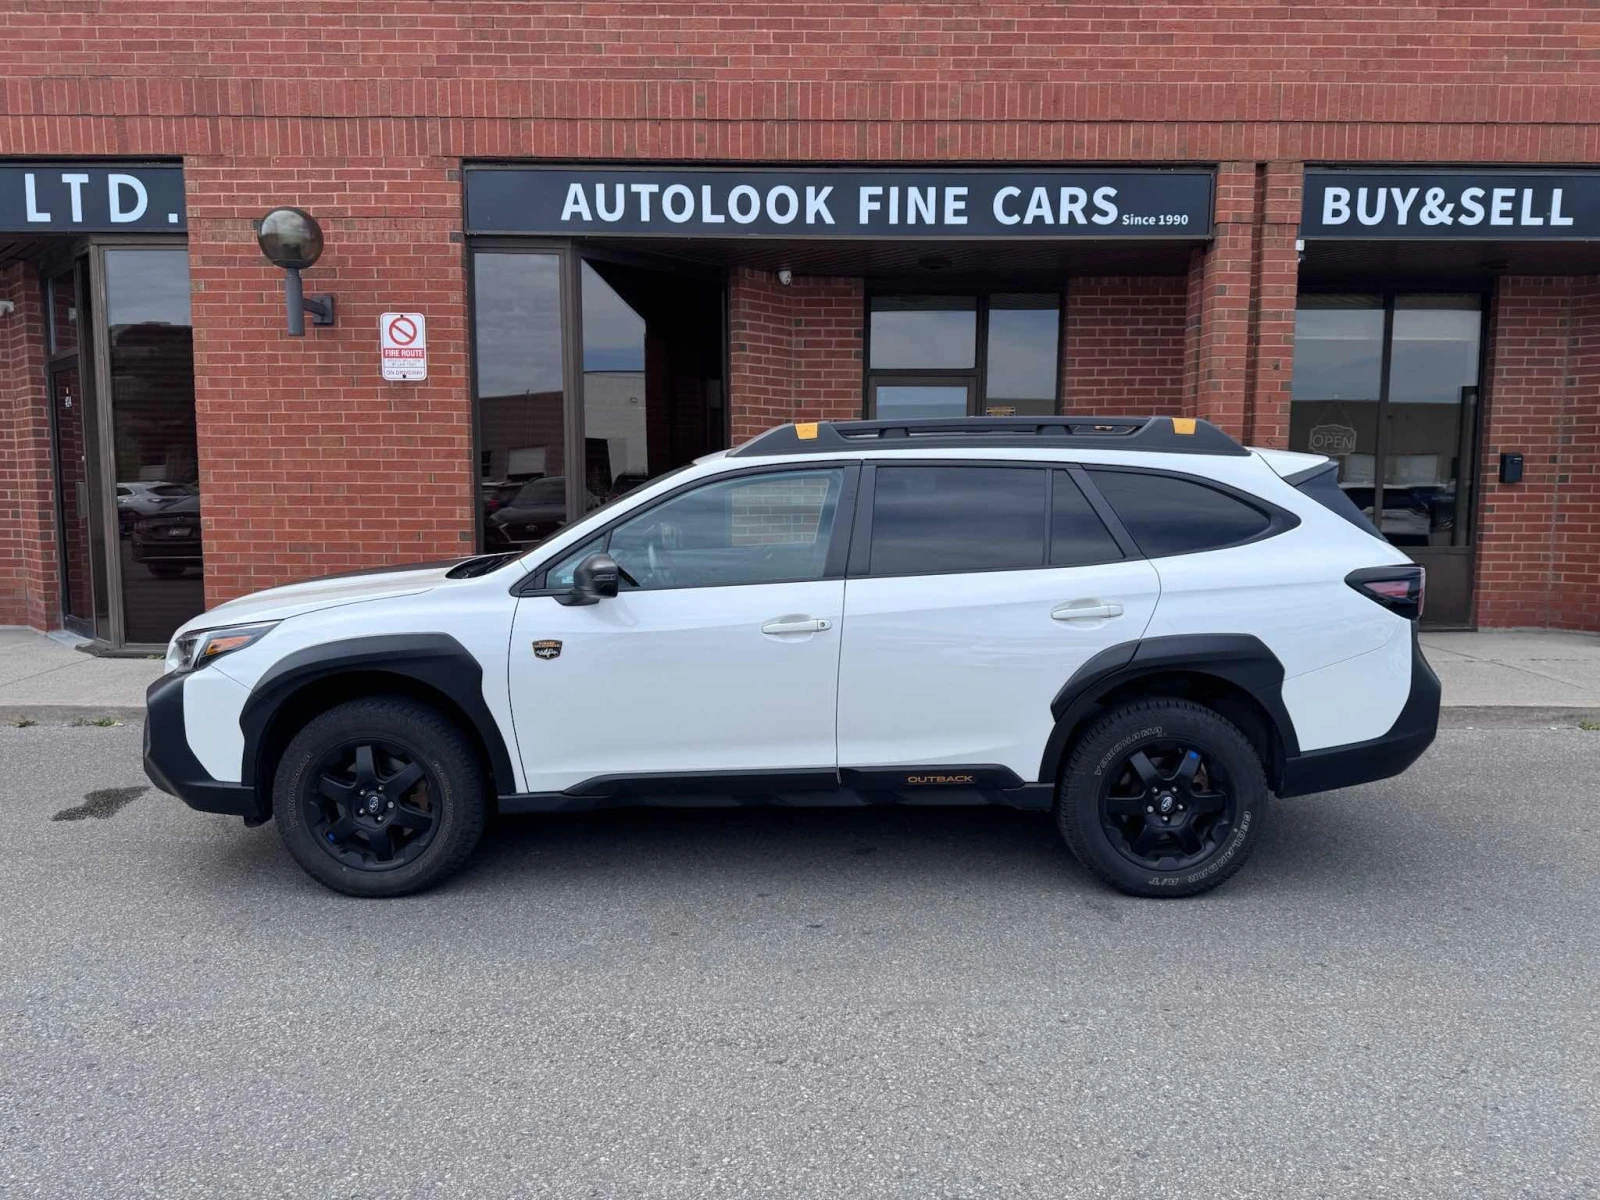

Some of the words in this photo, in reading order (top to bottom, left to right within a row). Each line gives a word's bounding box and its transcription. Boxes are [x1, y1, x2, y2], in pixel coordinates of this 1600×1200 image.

[24, 172, 179, 224] LTD.
[560, 182, 836, 225] AUTOLOOK
[858, 186, 969, 226] FINE
[992, 185, 1119, 226] CARS
[1322, 186, 1574, 226] BUY&SELL
[1122, 213, 1156, 225] Since
[1158, 214, 1189, 225] 1990
[385, 349, 400, 357] FIRE
[401, 349, 423, 357] ROUTE
[1312, 434, 1353, 449] OPEN
[1094, 726, 1163, 776] YOKOHAMA
[907, 775, 974, 783] OUTBACK
[1188, 811, 1252, 883] GEOLANDAR
